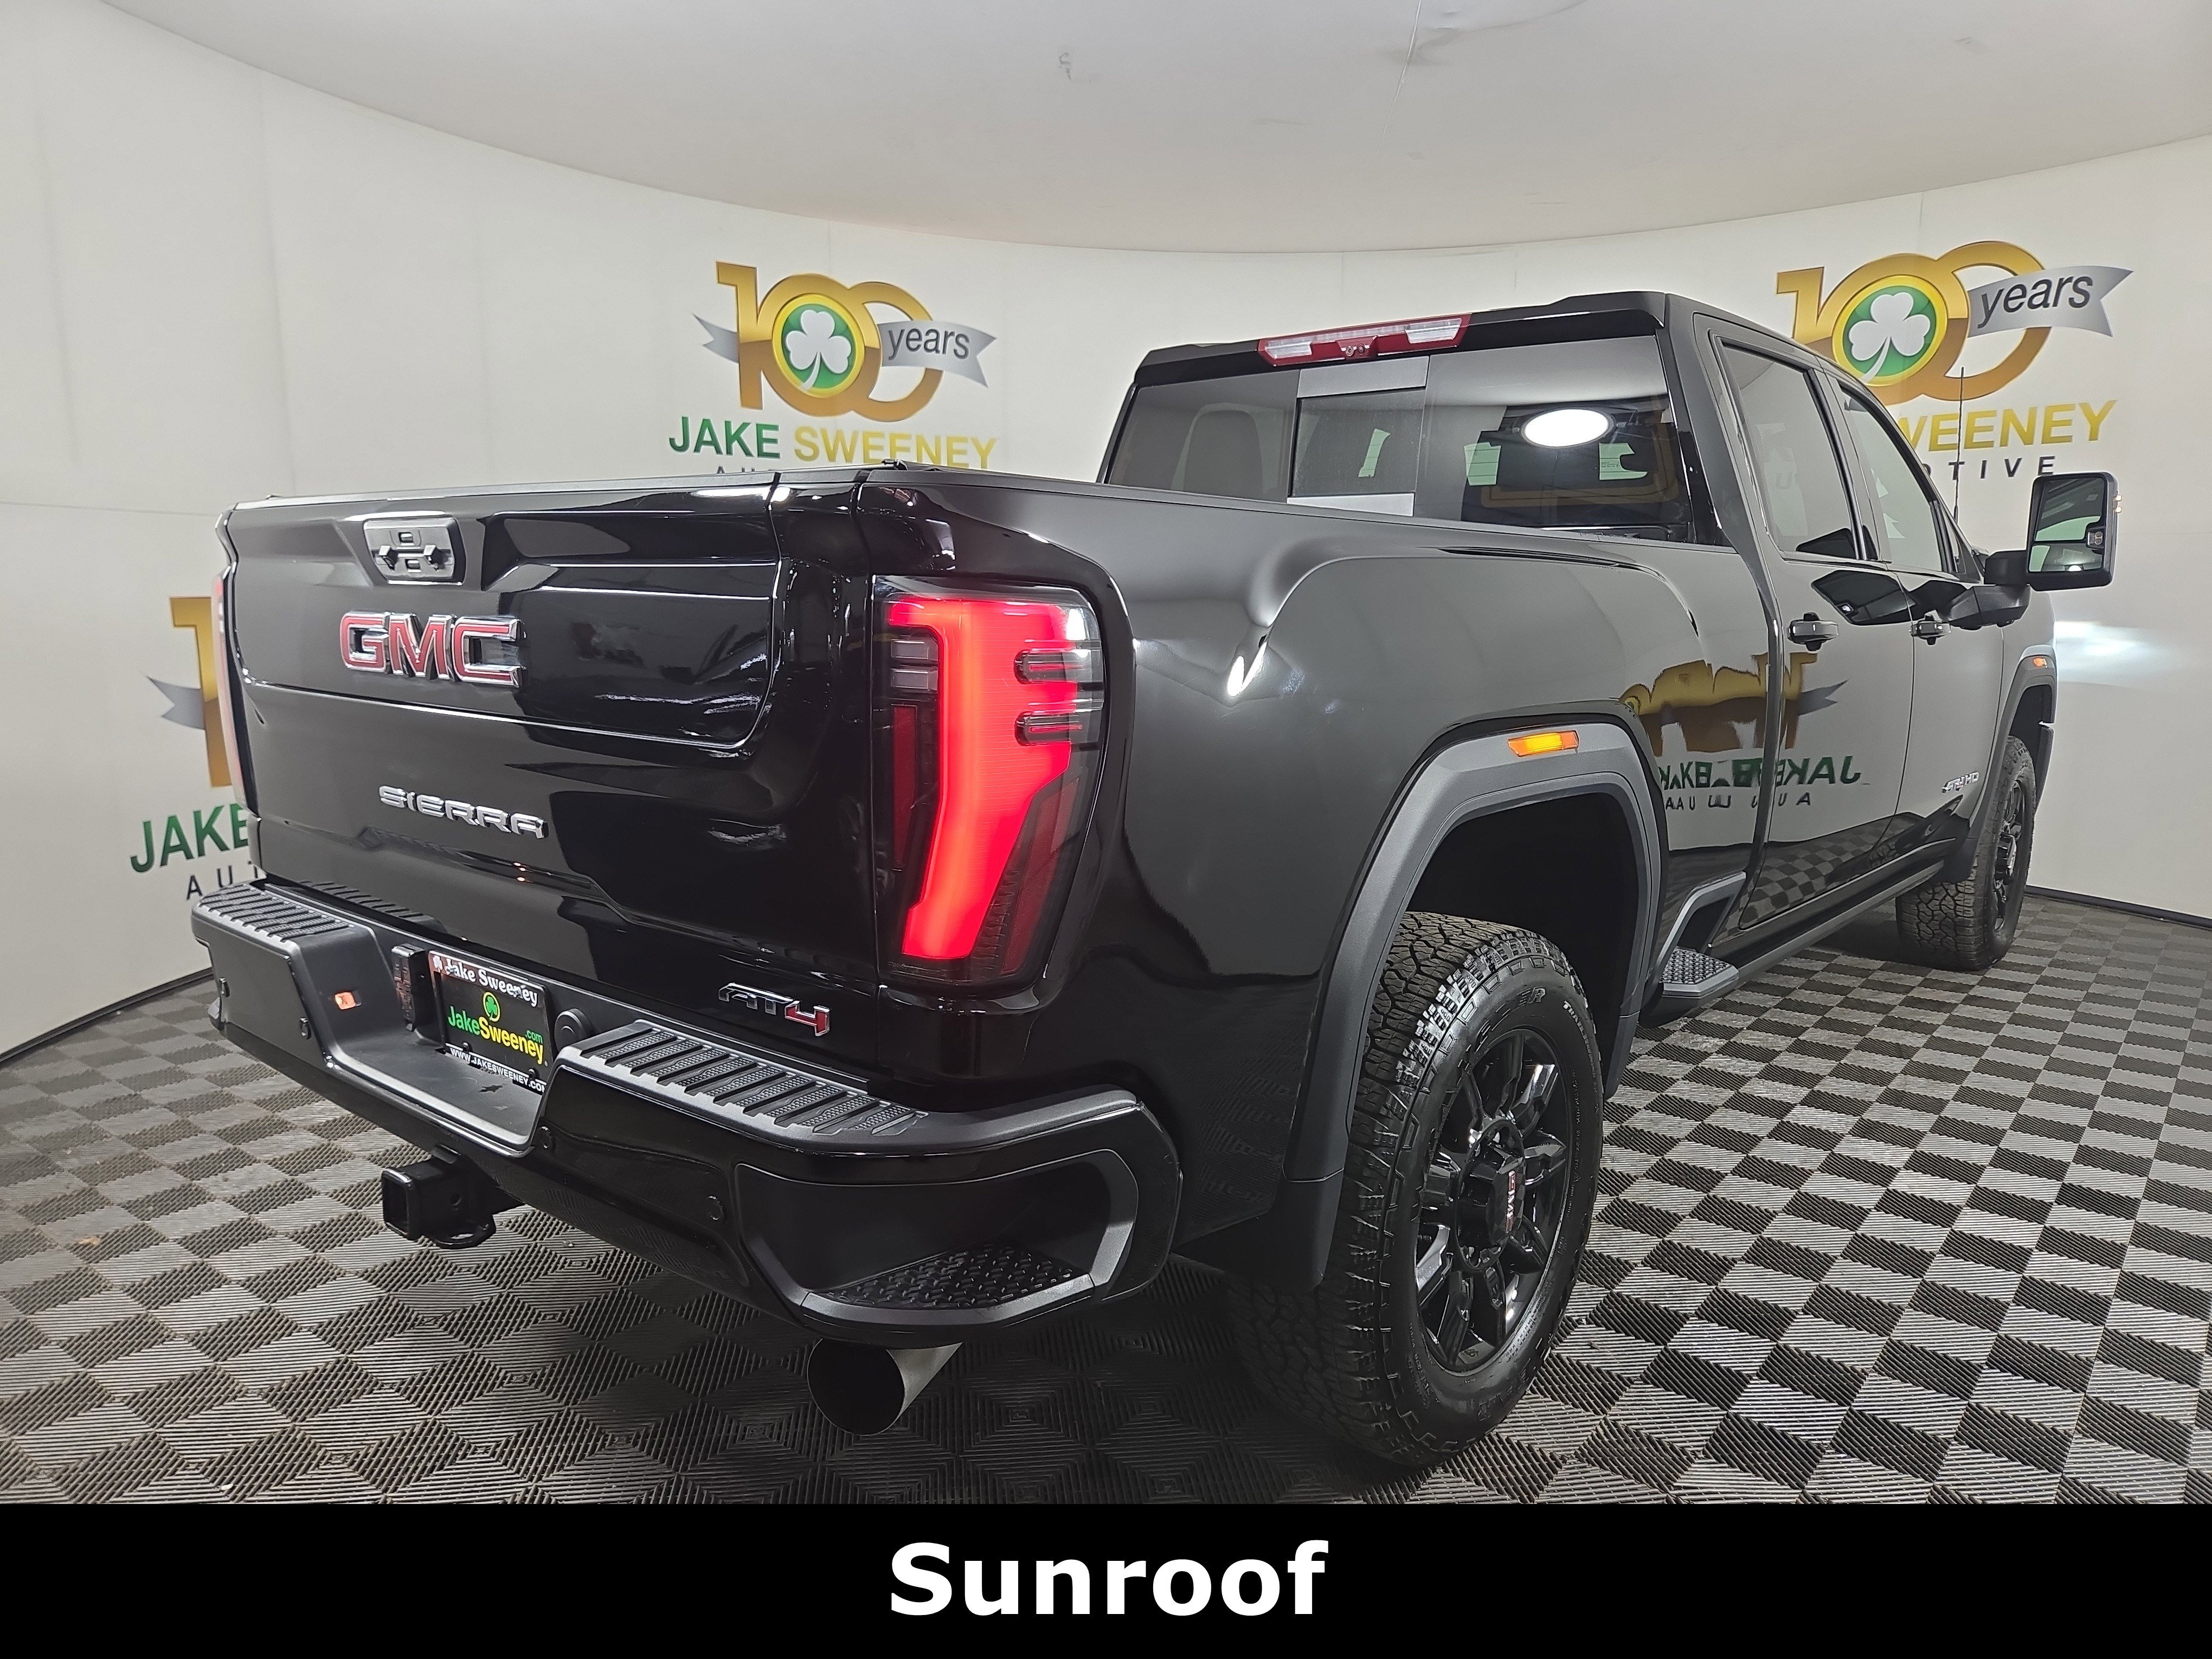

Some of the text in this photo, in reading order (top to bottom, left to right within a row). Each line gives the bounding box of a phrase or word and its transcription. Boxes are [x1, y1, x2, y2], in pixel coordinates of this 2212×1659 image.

[1977, 275, 2093, 329] years
[888, 327, 970, 360] years
[669, 416, 997, 469] JAKE SWEENEY
[340, 611, 526, 688] GMC
[130, 802, 249, 873] JAKE
[379, 786, 549, 839] SIERRA
[445, 958, 538, 1007] Jake Sweeney
[718, 982, 830, 1037] AT4
[448, 1006, 543, 1065] JakeSweeney
